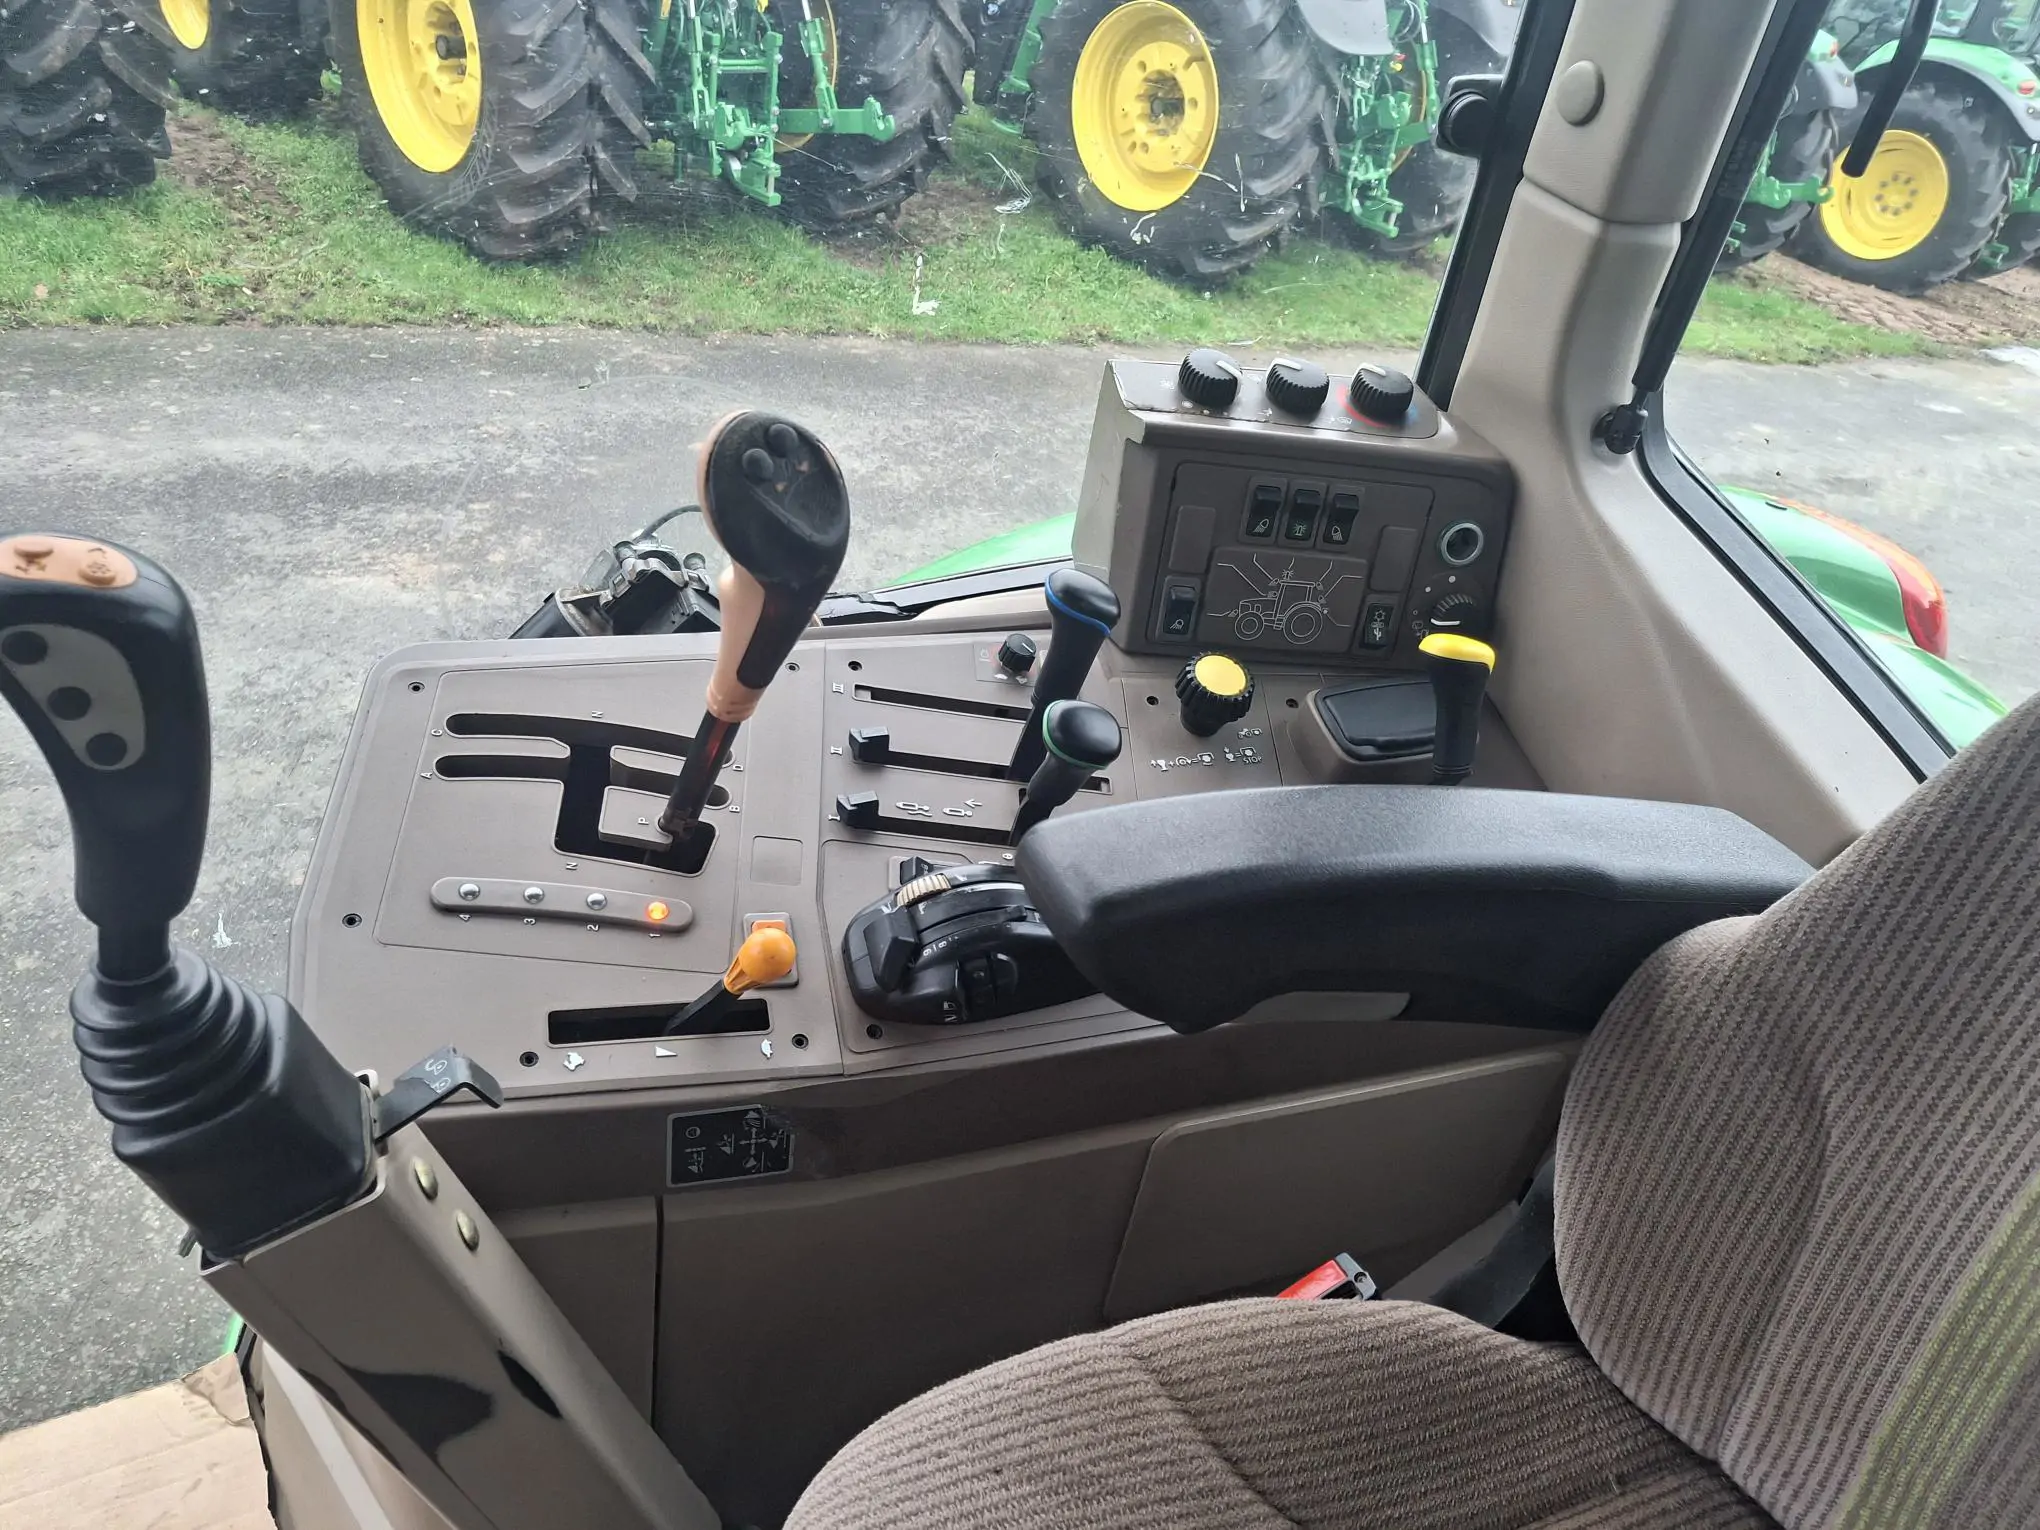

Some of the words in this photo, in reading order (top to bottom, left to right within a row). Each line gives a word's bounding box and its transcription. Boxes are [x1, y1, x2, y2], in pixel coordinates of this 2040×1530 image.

[1243, 756, 1261, 764] STOP
[420, 771, 432, 779] A
[459, 913, 470, 922] 4
[587, 924, 598, 932] 2
